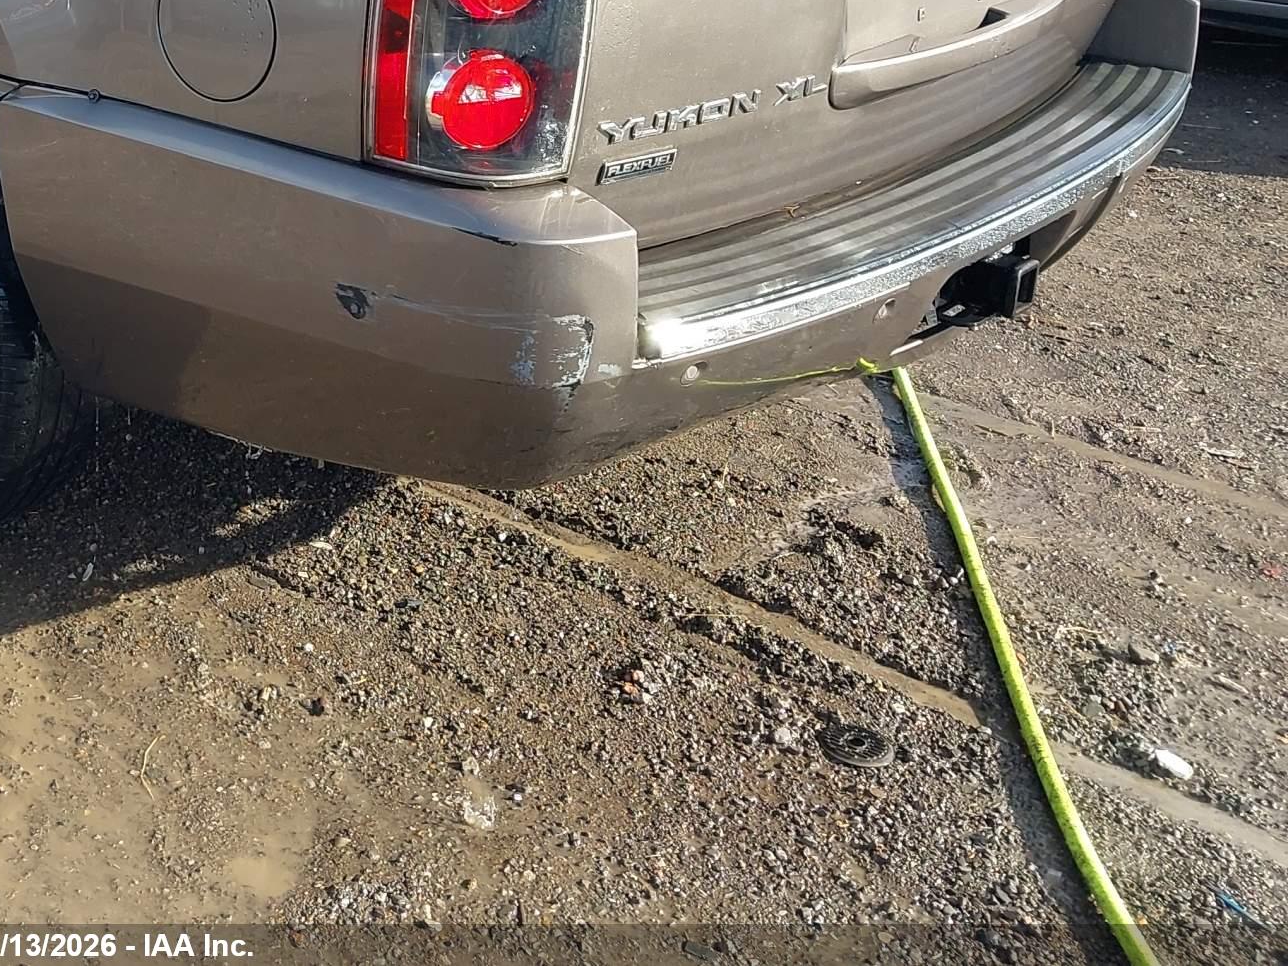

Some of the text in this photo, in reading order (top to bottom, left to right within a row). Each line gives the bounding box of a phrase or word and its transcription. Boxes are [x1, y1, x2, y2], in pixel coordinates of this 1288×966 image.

[598, 74, 828, 144] YUKON XL
[606, 152, 674, 178] FLEXFUEL
